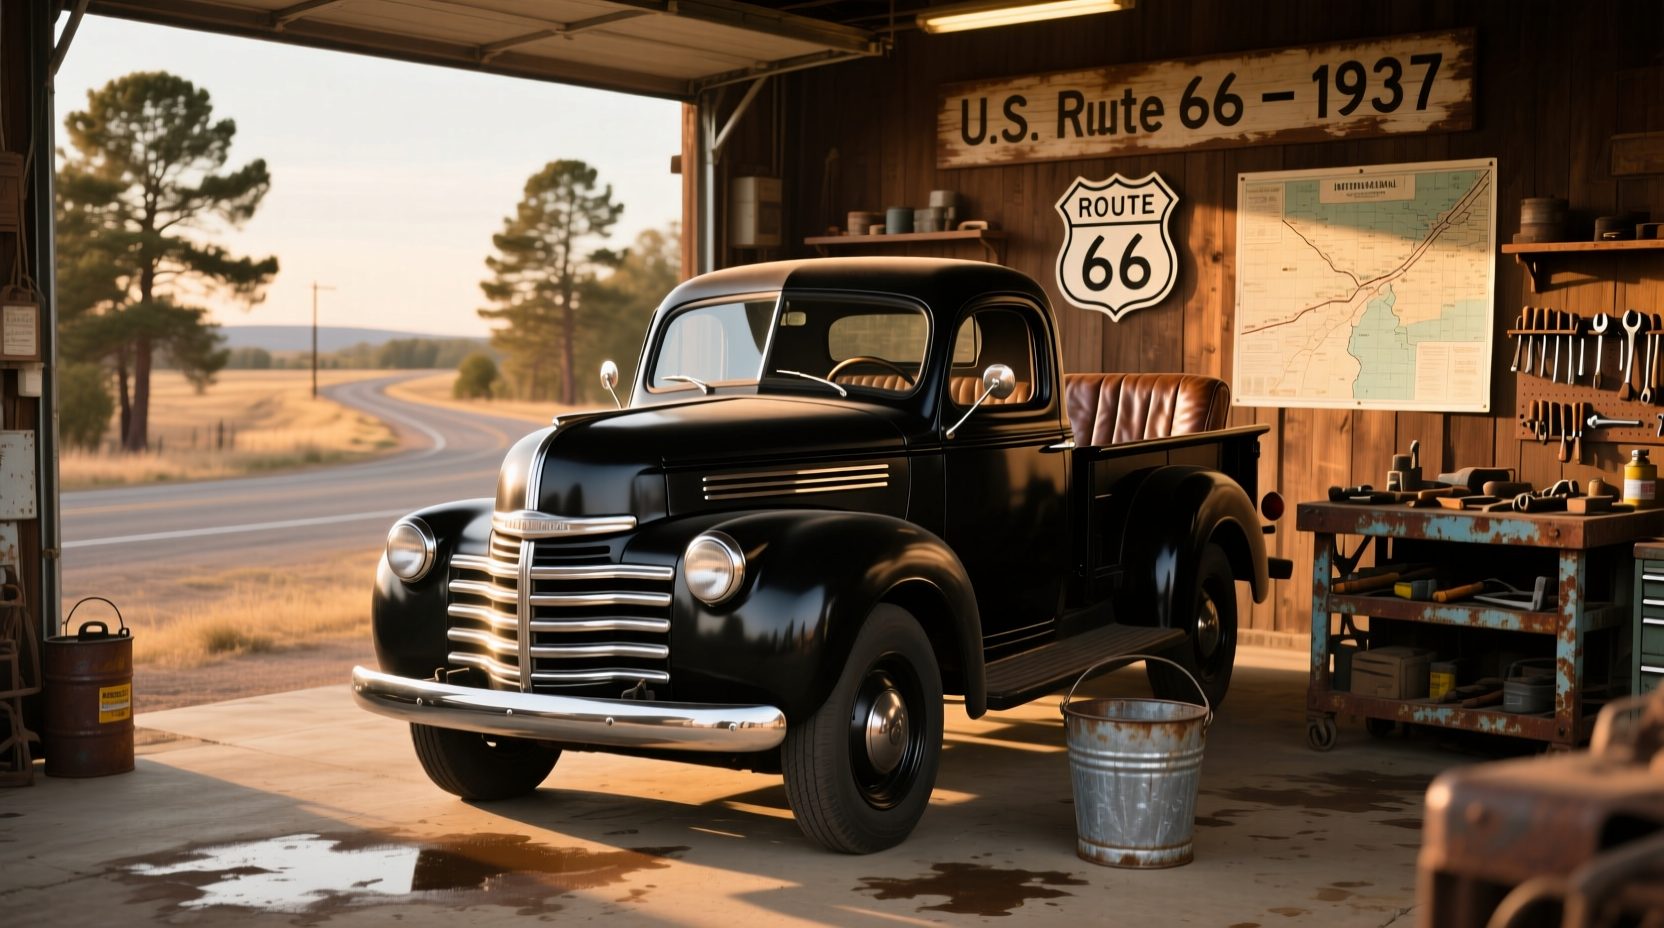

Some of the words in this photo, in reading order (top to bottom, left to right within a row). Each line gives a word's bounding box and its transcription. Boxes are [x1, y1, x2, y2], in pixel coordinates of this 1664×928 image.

[960, 95, 1039, 146] U.S.
[1179, 72, 1244, 130] 66
[1311, 52, 1443, 119] 1937
[1079, 194, 1155, 218] ROUTE
[1082, 233, 1151, 291] 66
